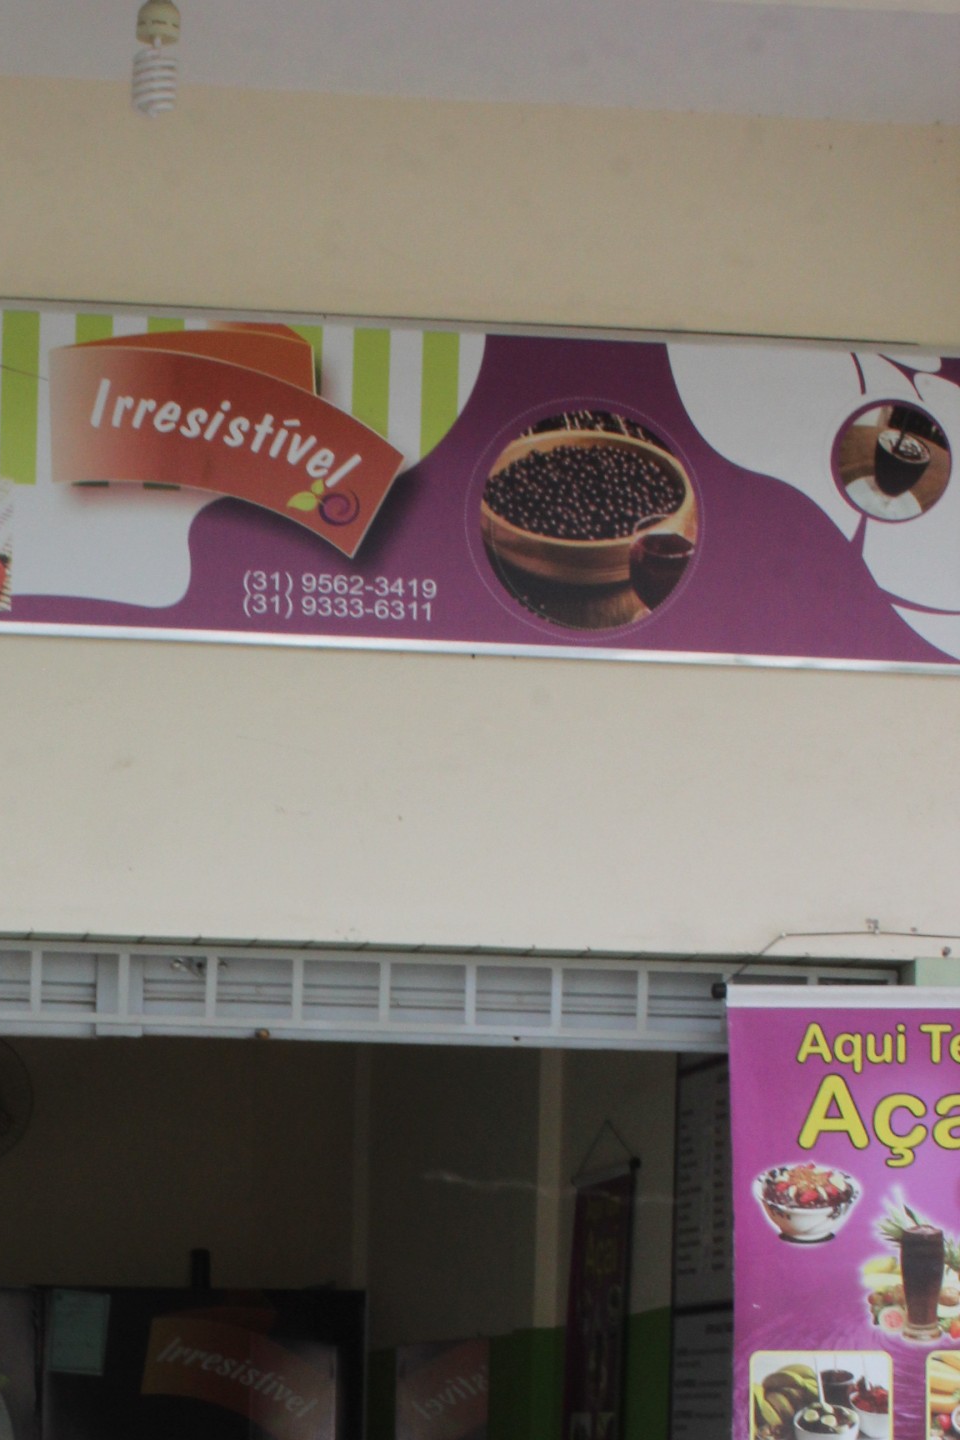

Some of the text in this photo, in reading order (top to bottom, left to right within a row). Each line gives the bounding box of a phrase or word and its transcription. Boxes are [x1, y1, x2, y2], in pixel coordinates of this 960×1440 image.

[90, 378, 362, 488] Irresistível
[243, 570, 437, 599] (31) 9562-3419
[243, 593, 432, 621] (31) 9333-6311
[796, 1022, 906, 1075] Aqui
